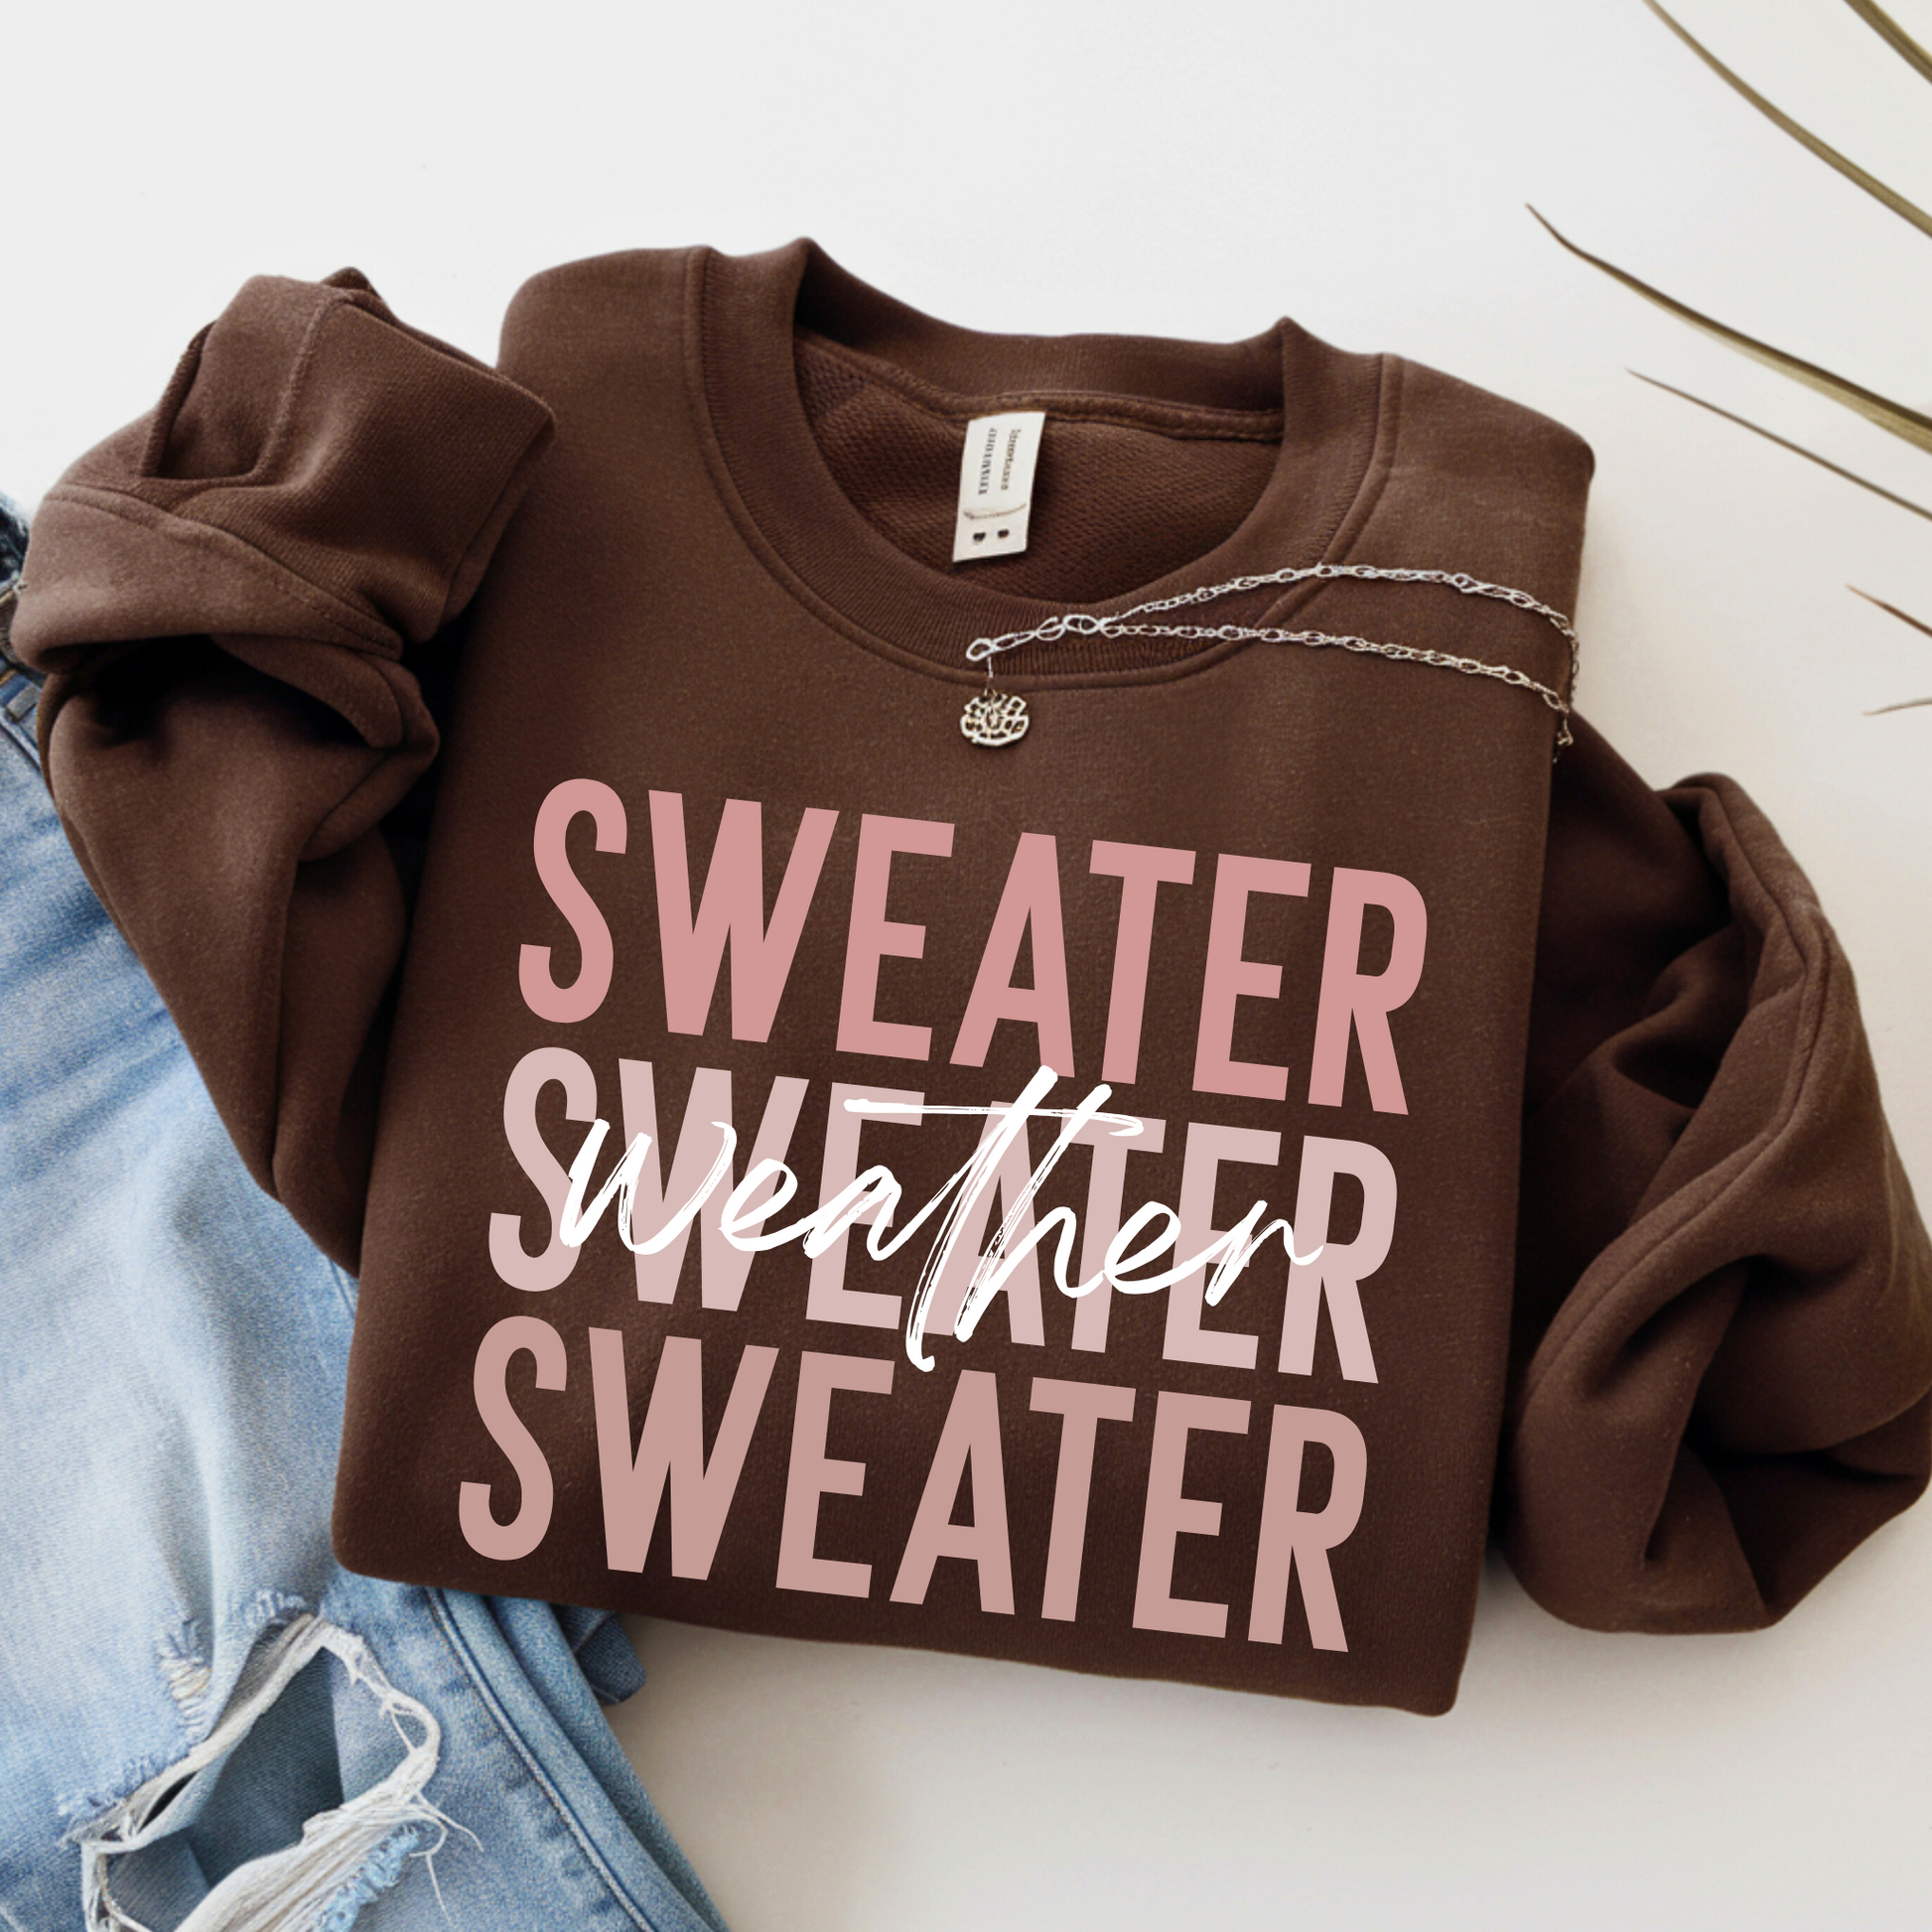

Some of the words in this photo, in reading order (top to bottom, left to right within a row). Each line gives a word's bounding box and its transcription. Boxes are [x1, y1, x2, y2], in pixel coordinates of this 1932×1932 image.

[519, 778, 1427, 1114] SWEATER
[489, 1047, 1397, 1383] SWEATER
[560, 1065, 1324, 1372] weather
[460, 1316, 1367, 1652] SWEATER
